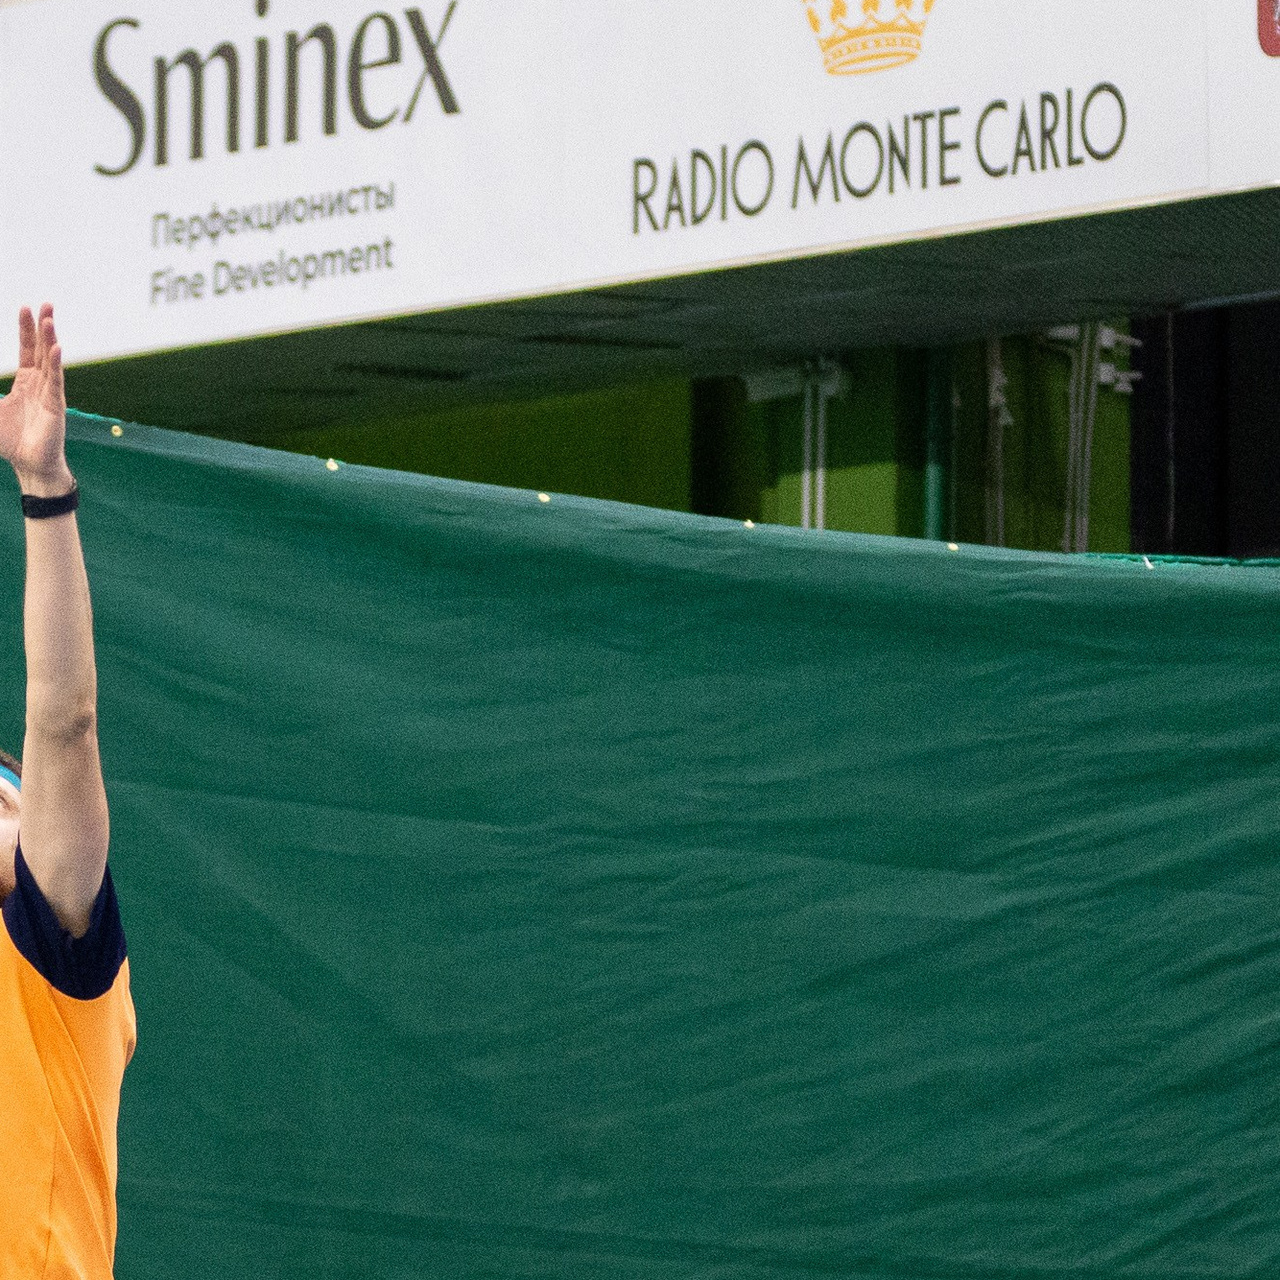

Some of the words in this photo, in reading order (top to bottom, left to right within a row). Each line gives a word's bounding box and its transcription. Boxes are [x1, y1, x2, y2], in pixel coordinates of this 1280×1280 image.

[631, 138, 775, 235] RADIO
[791, 106, 962, 210] MONTE
[974, 81, 1128, 179] CARLO
[151, 180, 396, 249] Перфекционисты
[150, 267, 204, 306] Fine
[212, 235, 395, 298] Development
